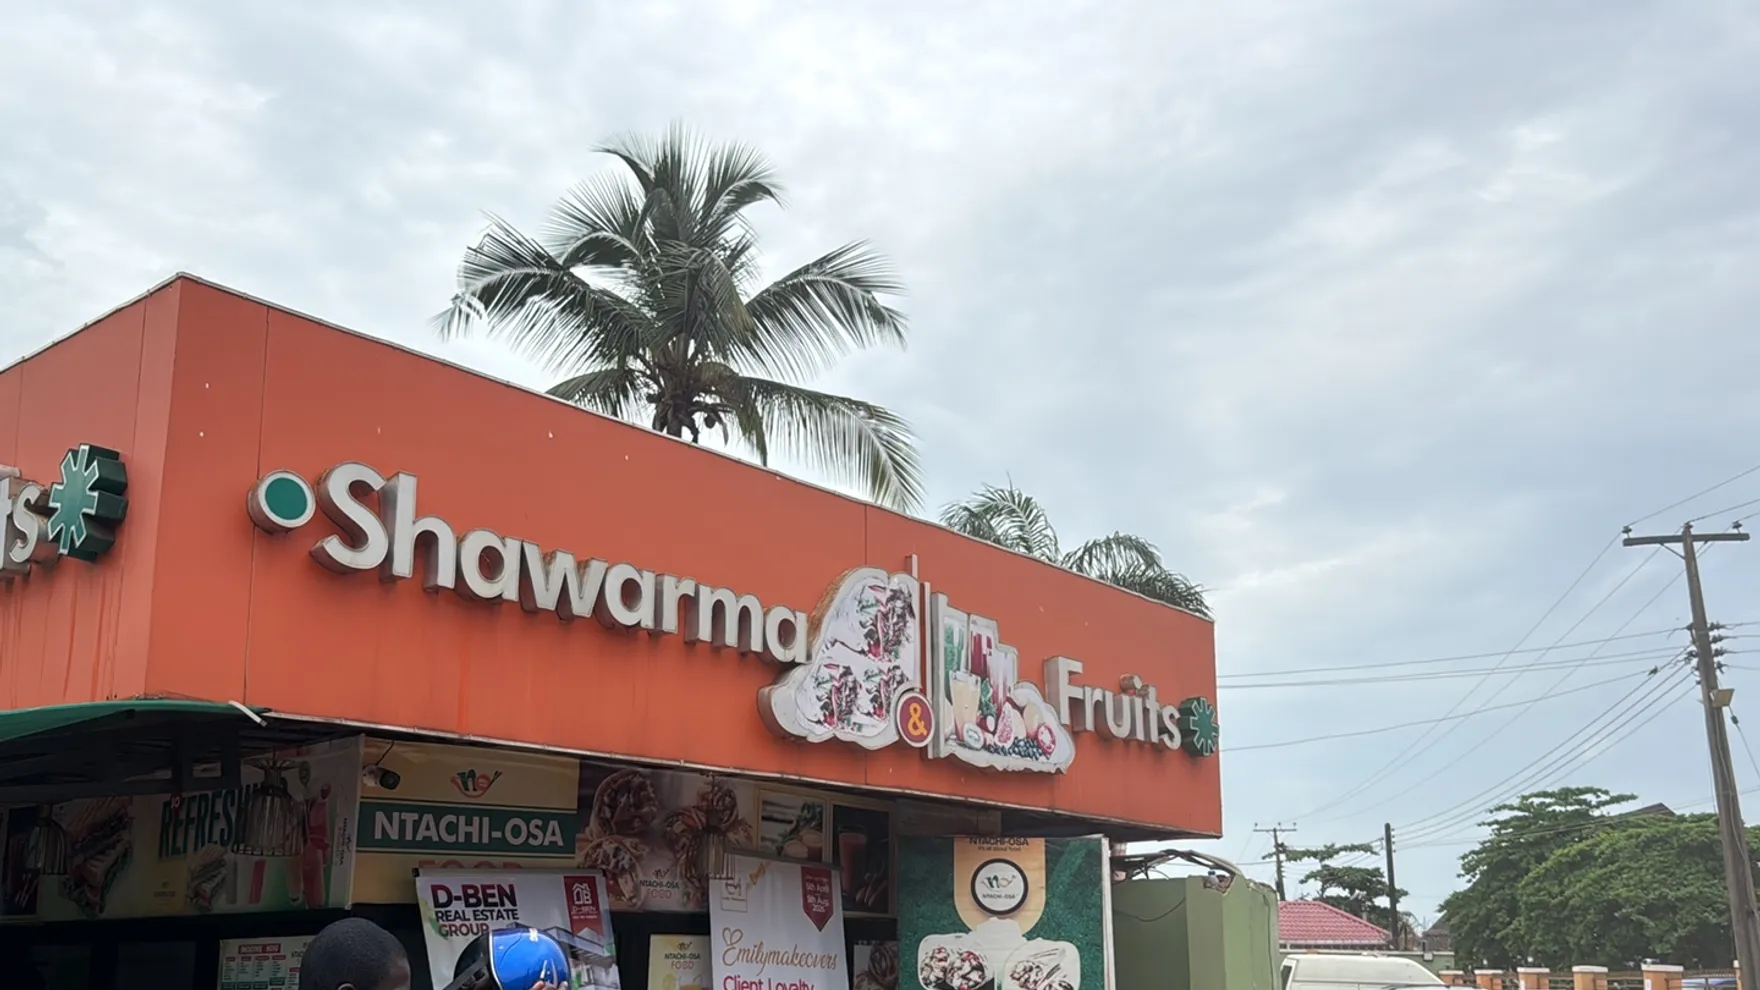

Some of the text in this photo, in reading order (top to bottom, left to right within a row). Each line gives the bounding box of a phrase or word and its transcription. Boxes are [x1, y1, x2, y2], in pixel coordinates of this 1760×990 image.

[311, 461, 1182, 751] Shawarma & Fruits
[374, 811, 564, 847] NTACHI-OSA
[969, 836, 1029, 846] NTACHI-OSA
[639, 880, 679, 889] NTACHI-OSA
[431, 884, 518, 908] D-BEN
[435, 909, 519, 922] REAL ESTATE
[439, 923, 490, 938] GROUP
[722, 936, 838, 976] Emilymakeovers
[671, 961, 694, 970] FOOD
[723, 975, 764, 990] Client
